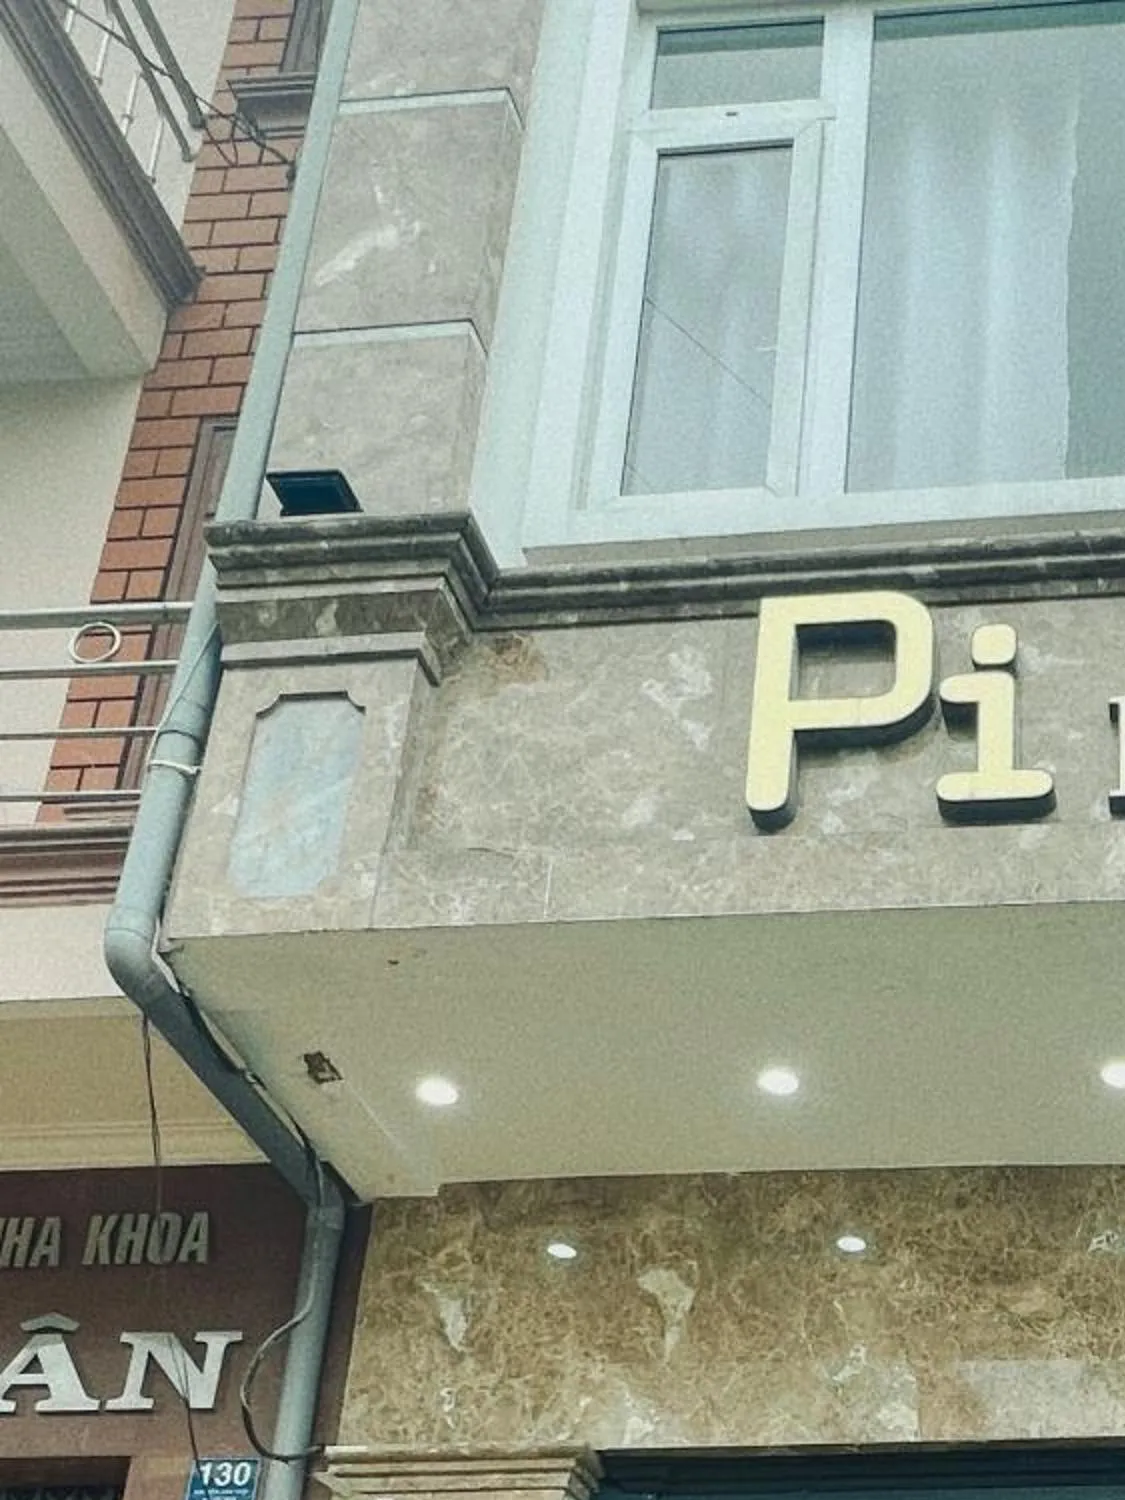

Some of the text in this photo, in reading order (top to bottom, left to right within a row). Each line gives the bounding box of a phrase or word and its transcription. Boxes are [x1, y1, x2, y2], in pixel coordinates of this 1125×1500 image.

[745, 590, 1055, 820] Pi
[81, 1211, 210, 1266] KHOA
[200, 1461, 252, 1487] 130
